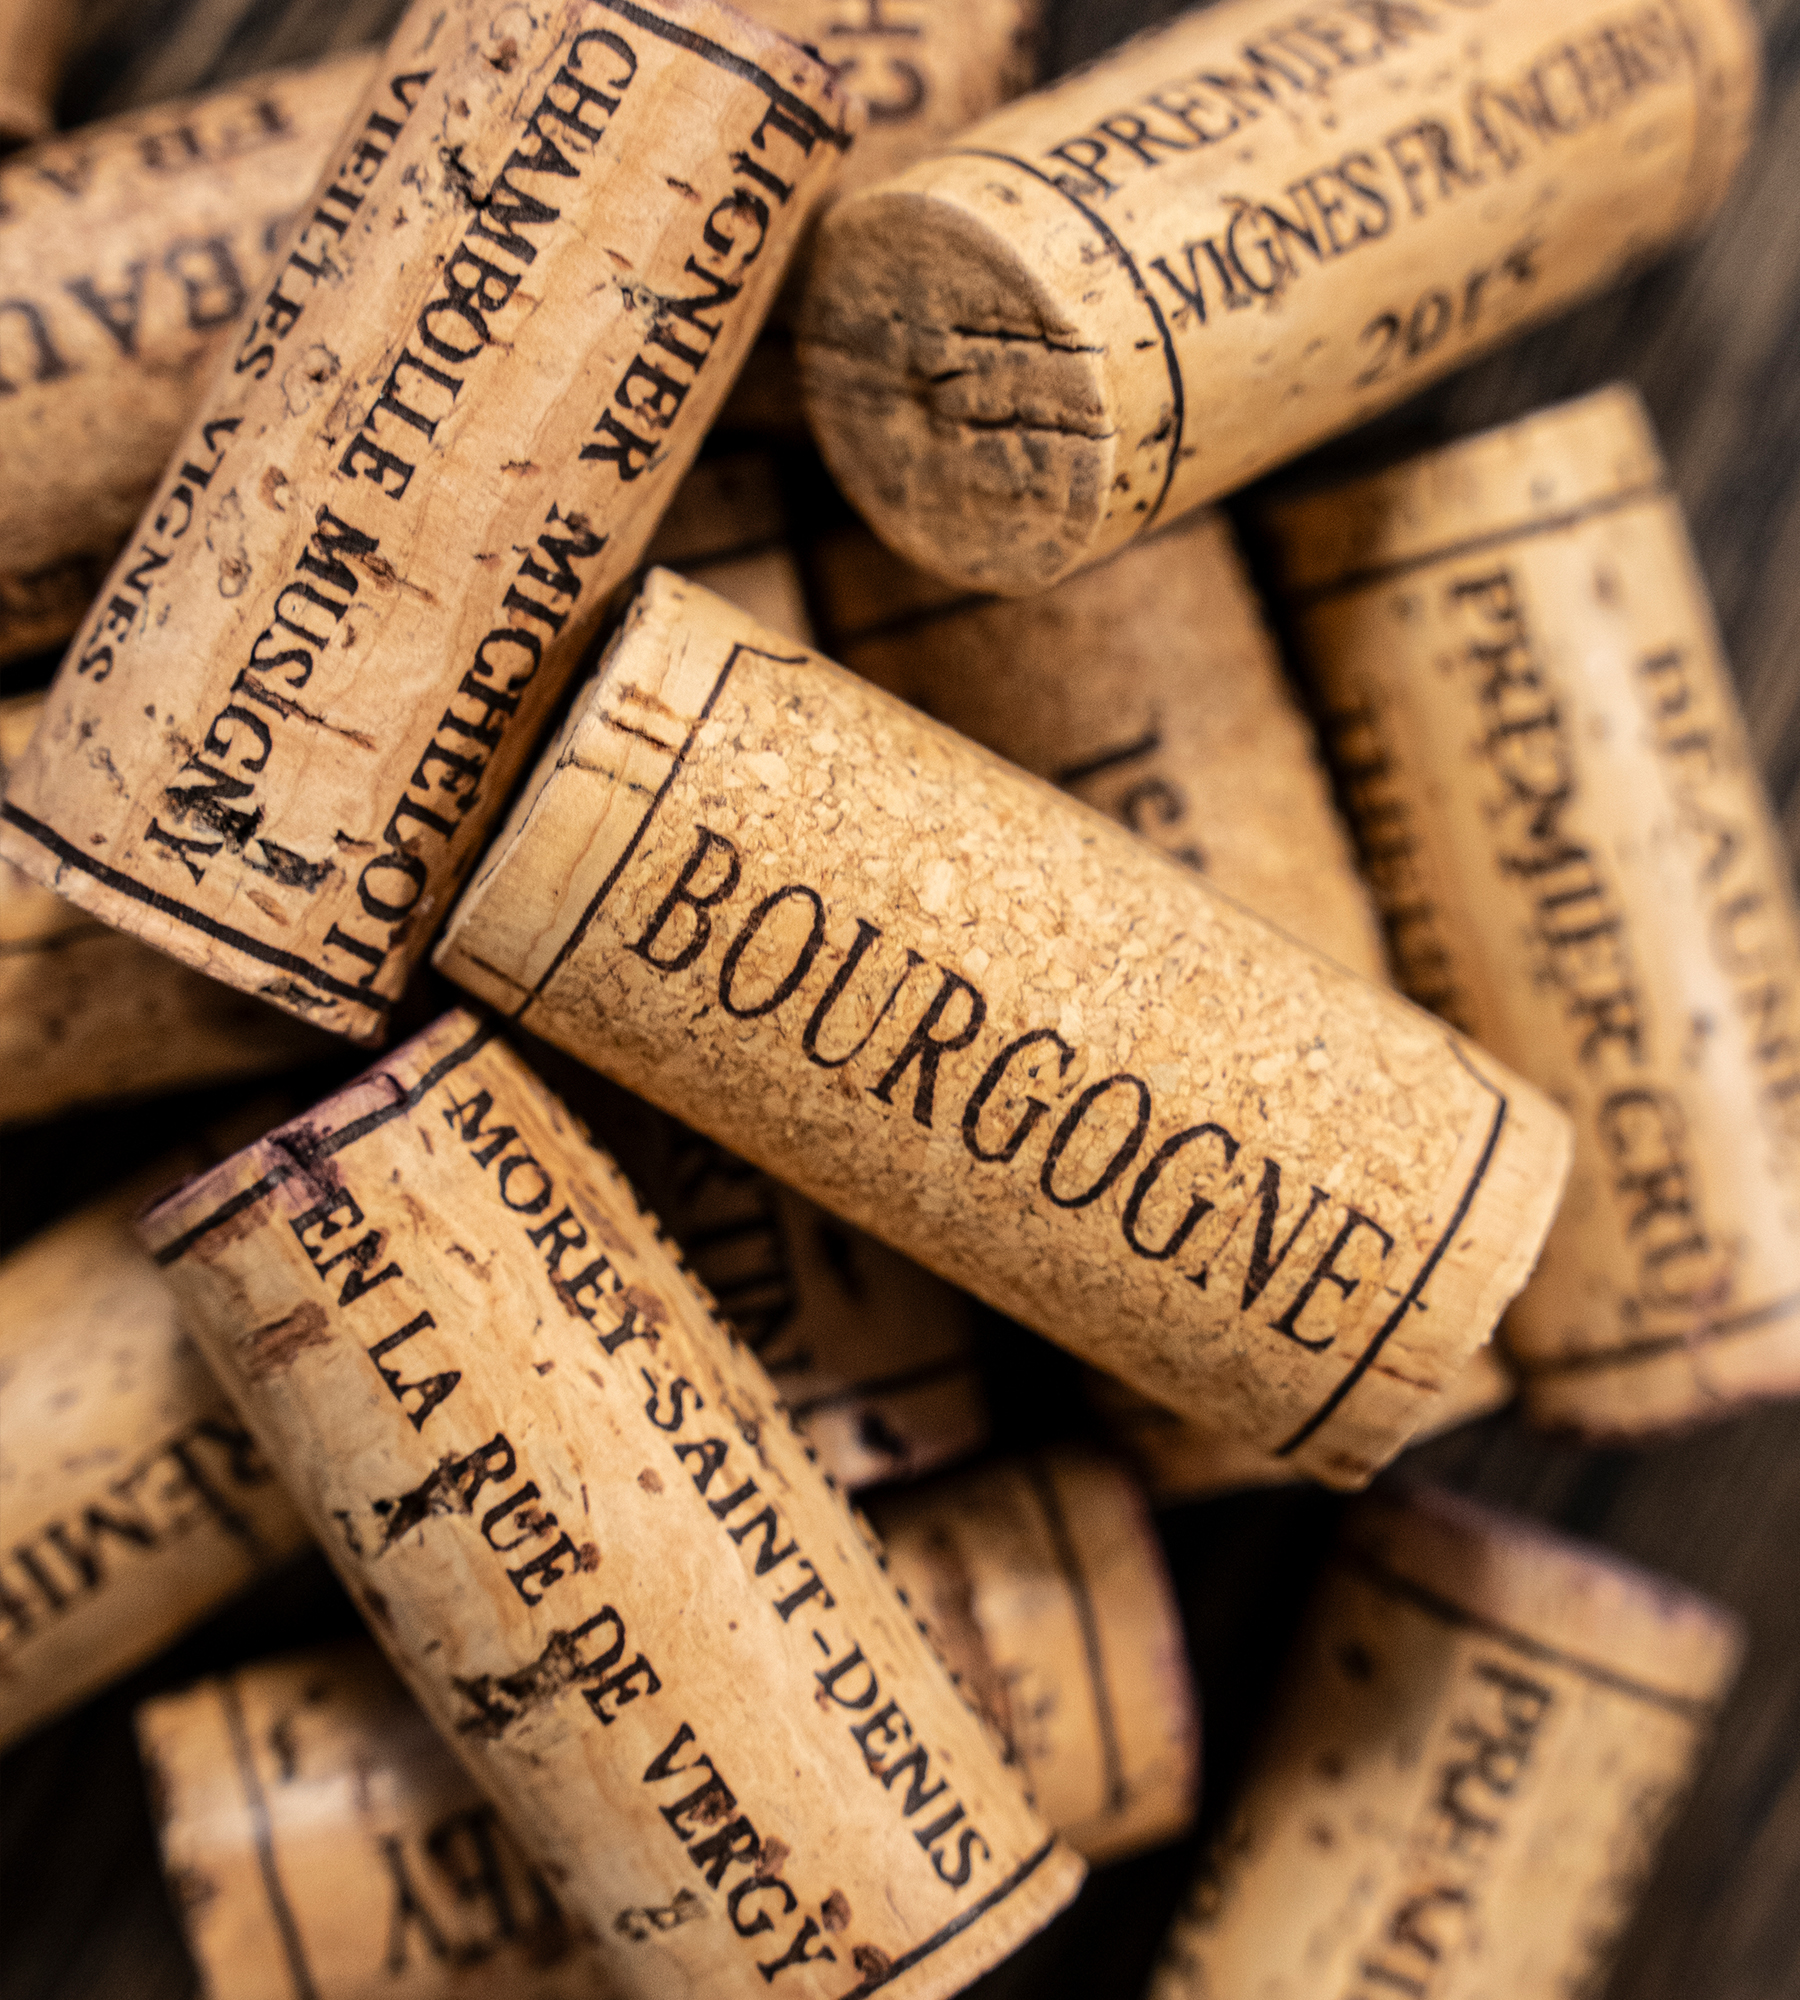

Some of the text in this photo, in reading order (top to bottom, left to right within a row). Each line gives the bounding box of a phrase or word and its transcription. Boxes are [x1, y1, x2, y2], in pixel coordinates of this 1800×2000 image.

[77, 68, 437, 684] VIEILLES VIGNES
[143, 29, 637, 886] CHAMBOLLE MUSIGNY
[322, 102, 824, 990] LIGNIER MICHELOT
[1149, 151, 1395, 328] VIGNES
[625, 825, 1394, 1353] BOURGOGNE
[288, 1187, 837, 1983] EN LA RUE DE VERGY
[442, 1088, 991, 1891] MOREY-SAINT-DENIS
